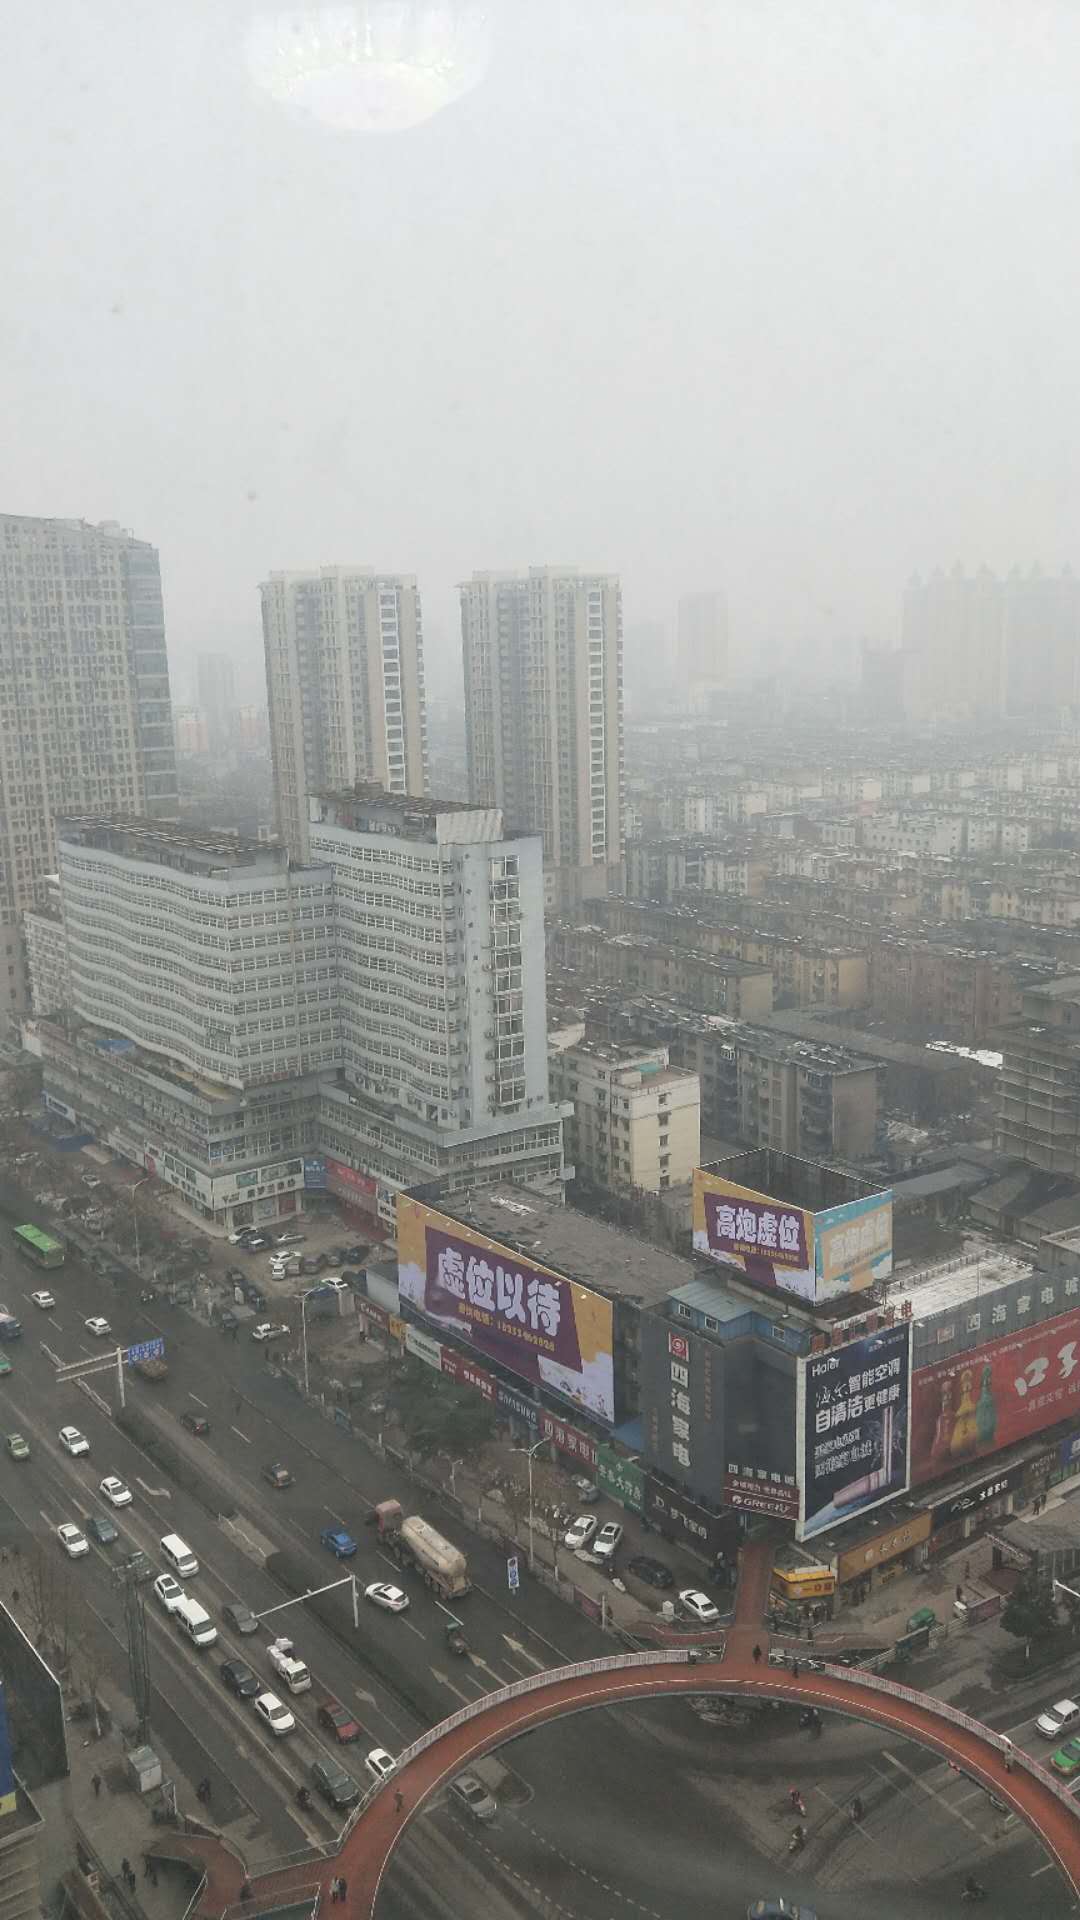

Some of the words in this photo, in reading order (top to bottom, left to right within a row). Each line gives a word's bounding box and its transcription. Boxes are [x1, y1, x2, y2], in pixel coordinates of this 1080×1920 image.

[715, 1204, 800, 1251] 高炮虚位
[438, 1247, 562, 1336] 虚位以待
[671, 1361, 690, 1468] 四海家电
[815, 1383, 901, 1434] 自清洁更健康
